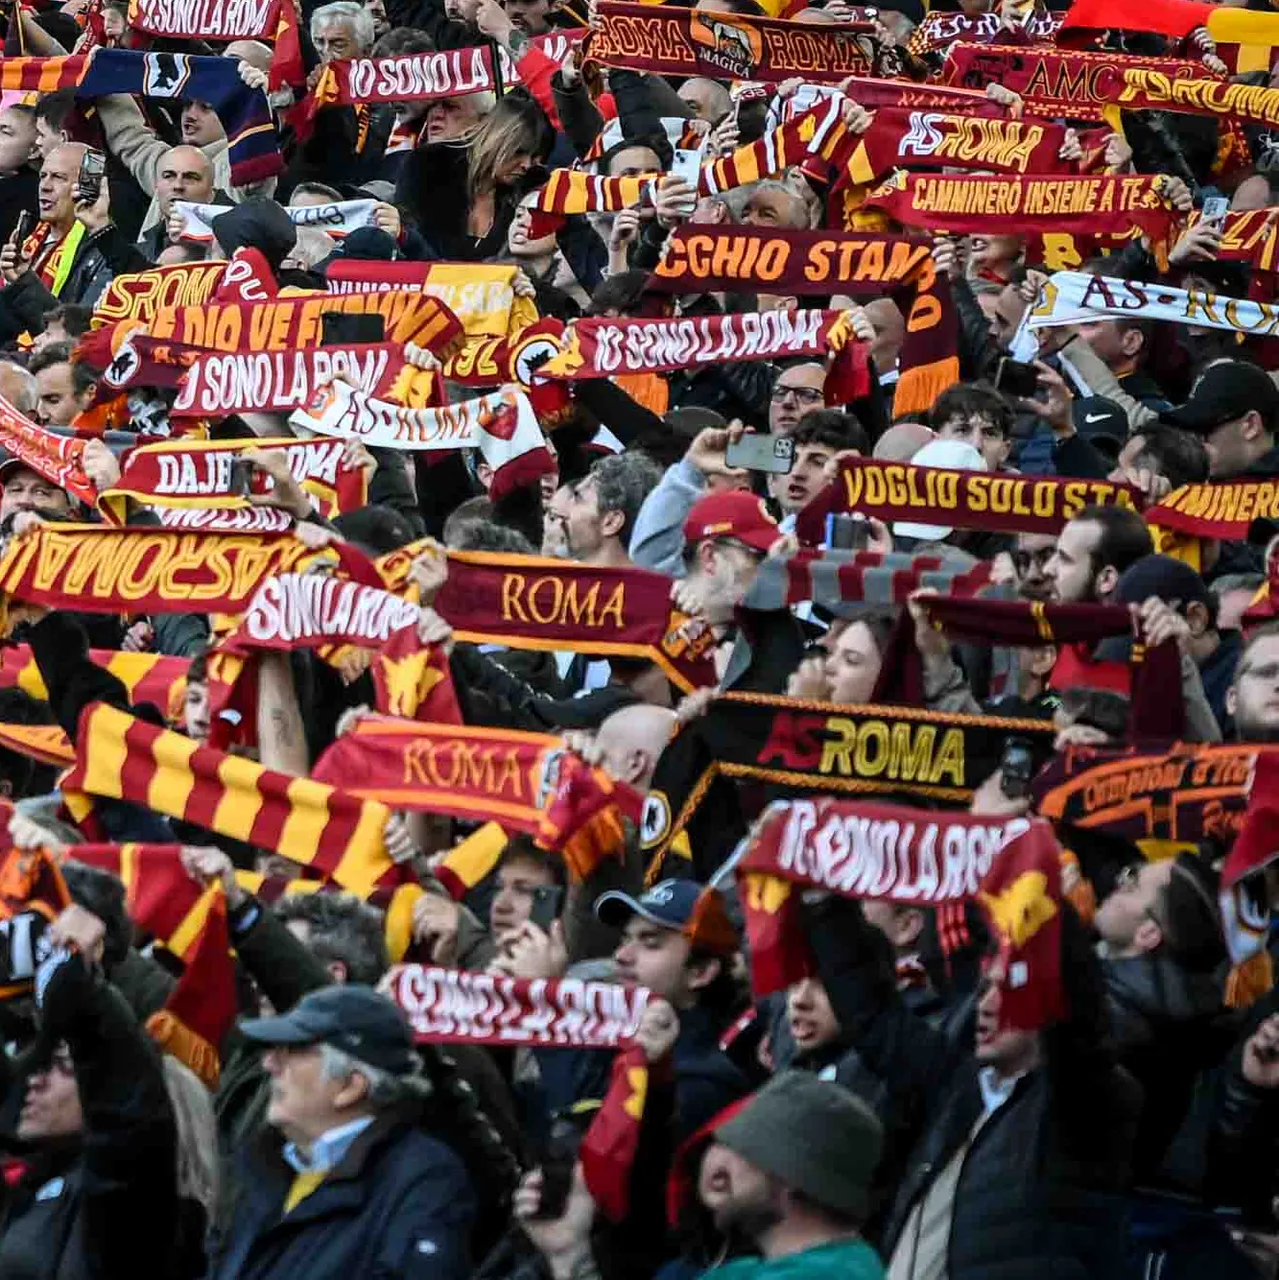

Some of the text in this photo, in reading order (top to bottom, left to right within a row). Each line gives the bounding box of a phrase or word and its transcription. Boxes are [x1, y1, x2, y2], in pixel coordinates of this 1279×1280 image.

[154, 453, 232, 494] DAJE
[843, 465, 1057, 519] VOGLIO SOLO
[500, 573, 625, 630] ROMA
[402, 739, 522, 797] ROMA
